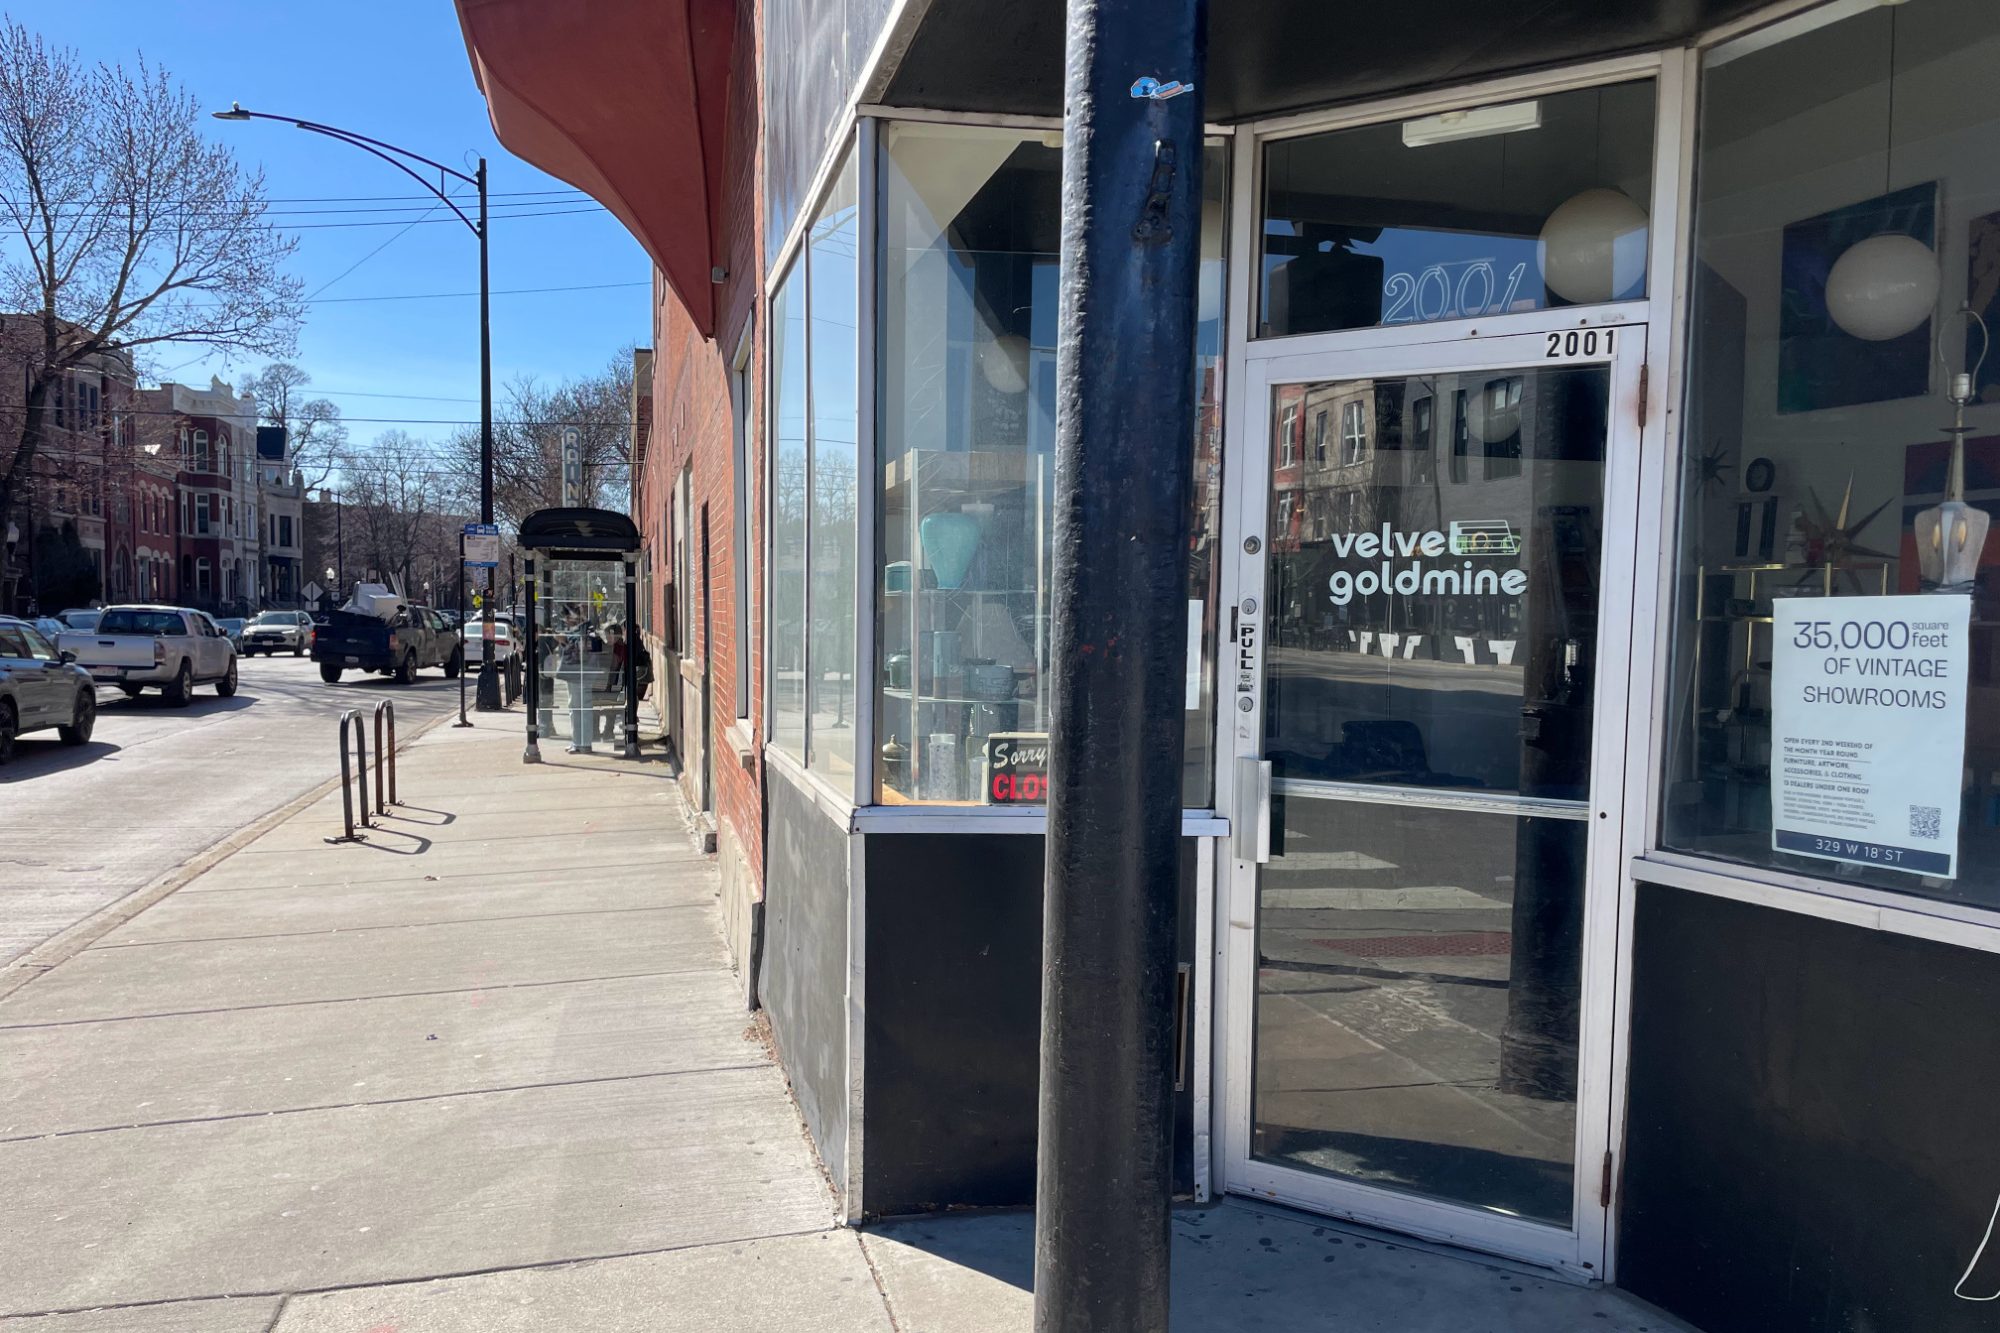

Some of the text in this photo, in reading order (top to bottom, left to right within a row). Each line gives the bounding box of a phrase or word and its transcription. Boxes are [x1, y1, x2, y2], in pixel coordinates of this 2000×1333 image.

[1546, 329, 1615, 358] 2001
[1331, 519, 1465, 558] velvet
[1329, 560, 1528, 606] goldmine
[1793, 621, 1910, 651] 35,000
[1911, 621, 1949, 632] square
[1240, 627, 1255, 670] PULL
[1911, 632, 1948, 648] feet
[1823, 657, 1948, 678] OF VINTAGE
[1802, 685, 1947, 709] SHOWROOMS
[993, 743, 1047, 769] Sorry
[1835, 741, 1863, 749] WEEKEND
[1831, 771, 1862, 780] CLOTHING
[1790, 780, 1814, 789] DEALERS
[1815, 783, 1836, 791] UNDER
[1837, 785, 1851, 793] ONE
[1852, 787, 1870, 795] ROOF
[1815, 839, 1904, 862] 329 W 18 ST
